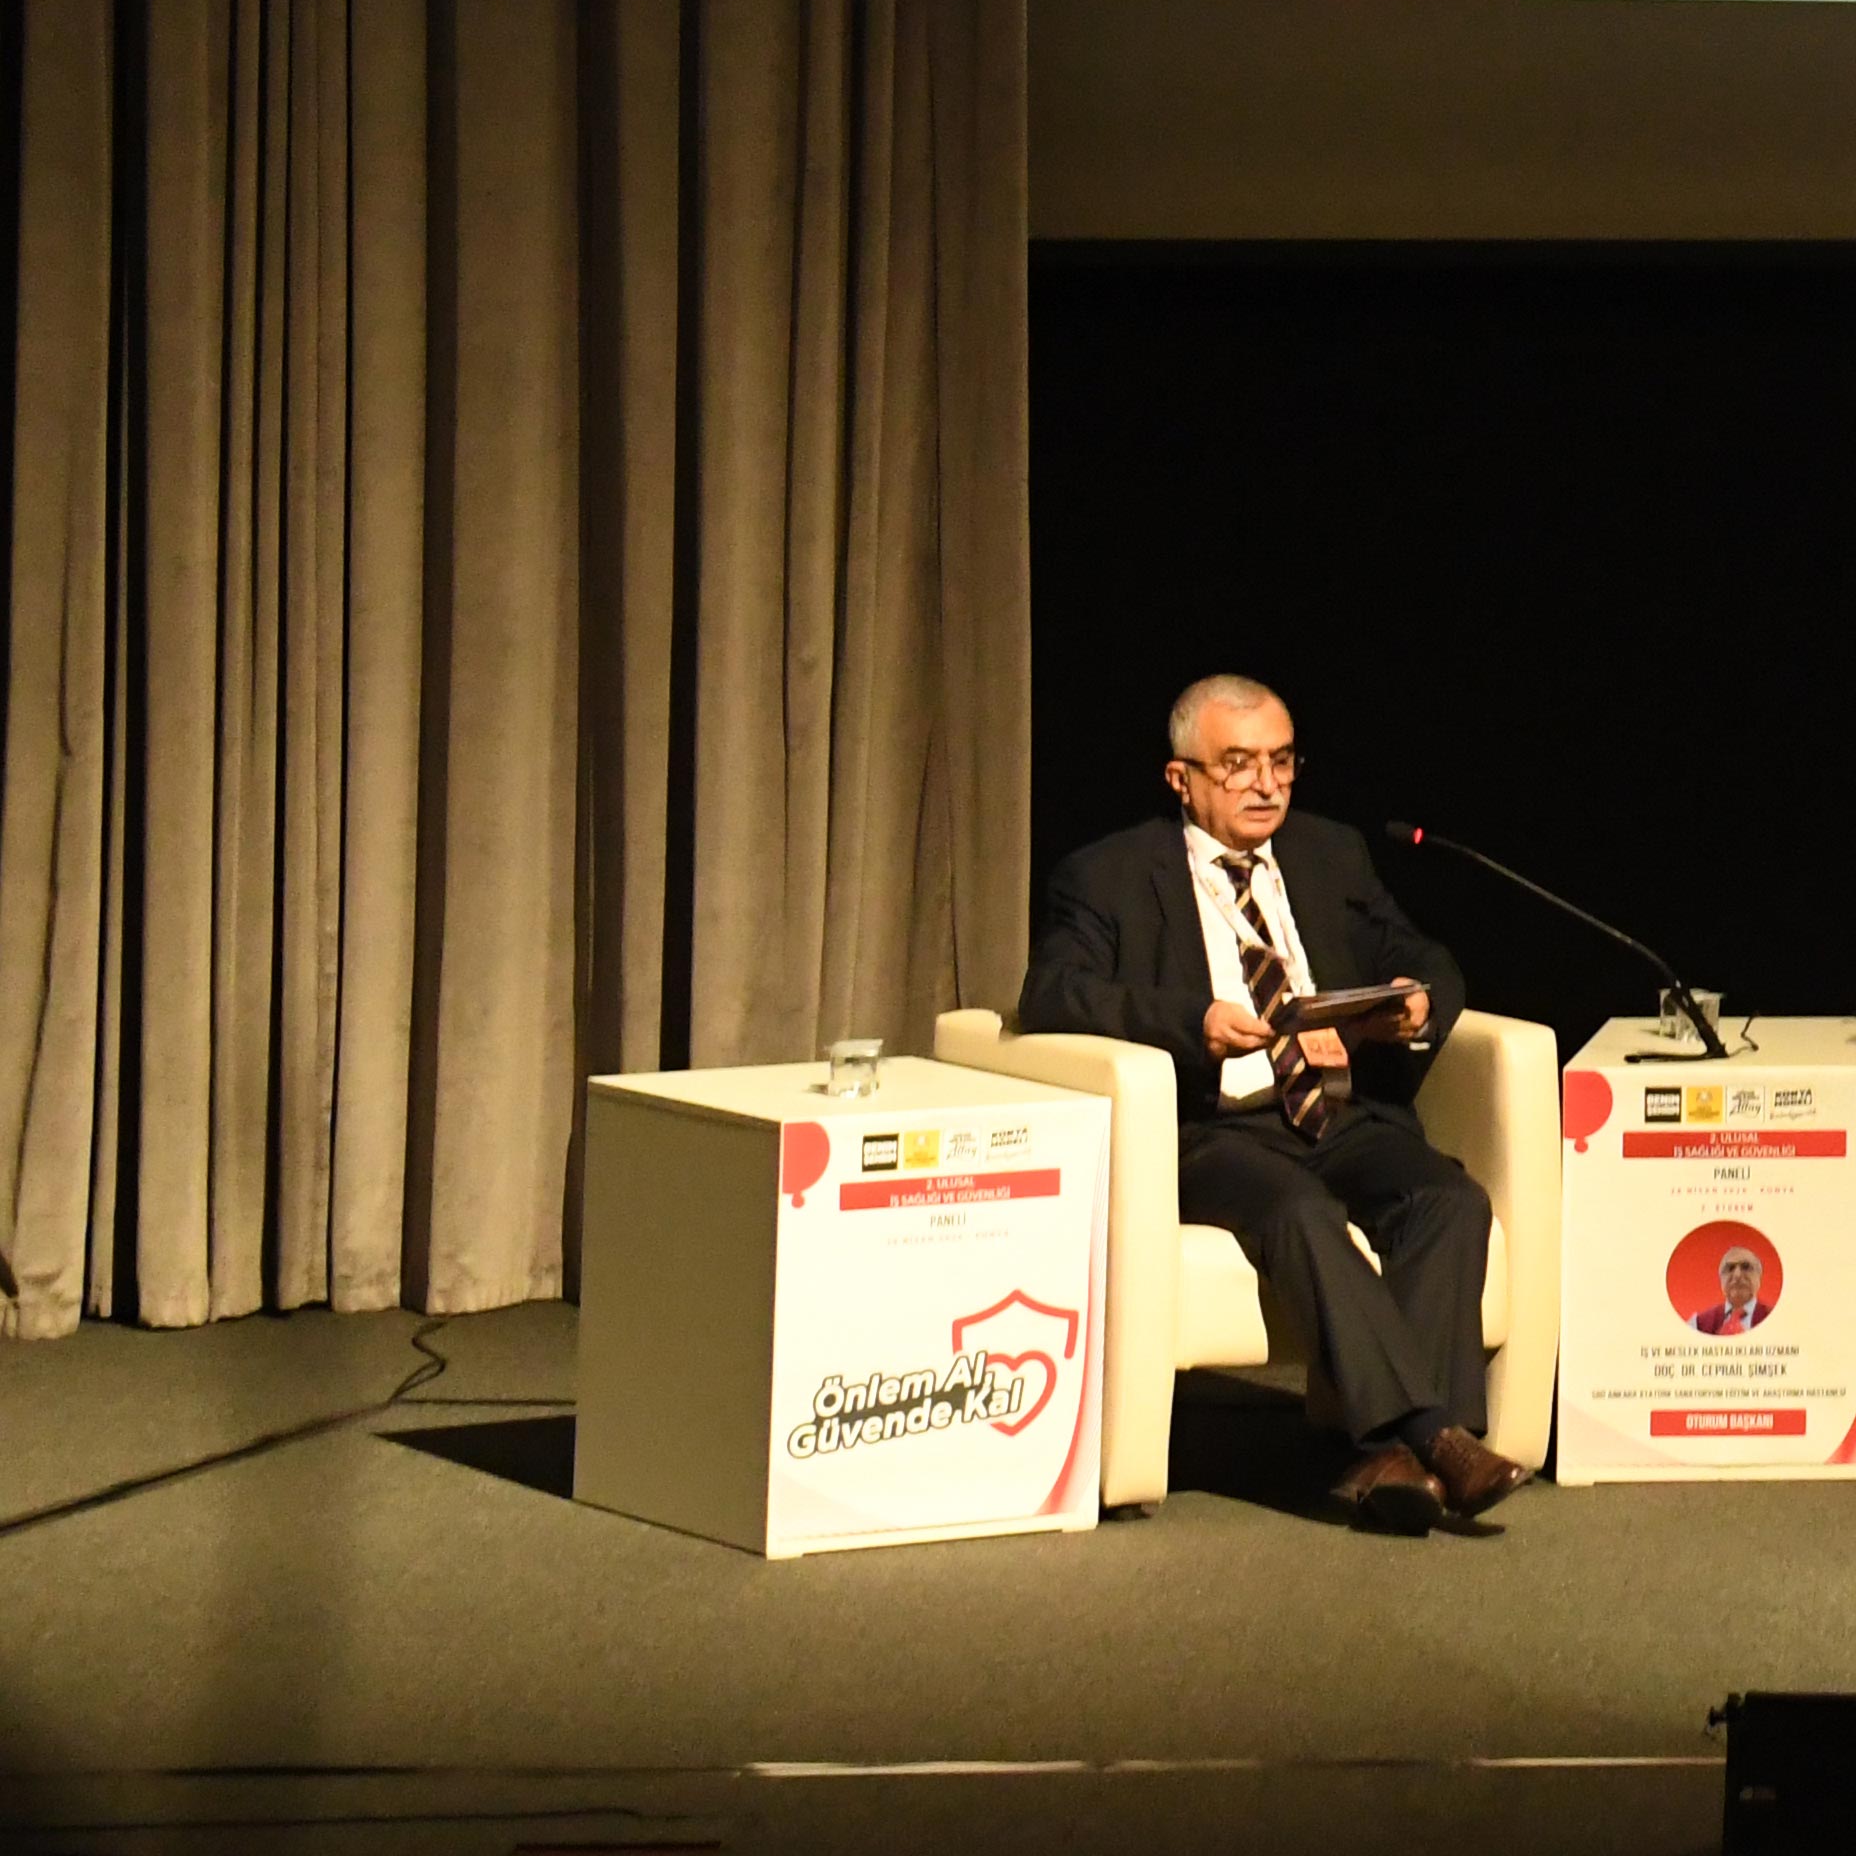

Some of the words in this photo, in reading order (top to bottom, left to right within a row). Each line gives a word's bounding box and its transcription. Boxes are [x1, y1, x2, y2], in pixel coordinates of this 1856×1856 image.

[1713, 1166, 1751, 1180] PANELİ
[787, 1397, 953, 1459] Güvende
[961, 1377, 1024, 1424] Kal
[813, 1369, 937, 1418] Önlem
